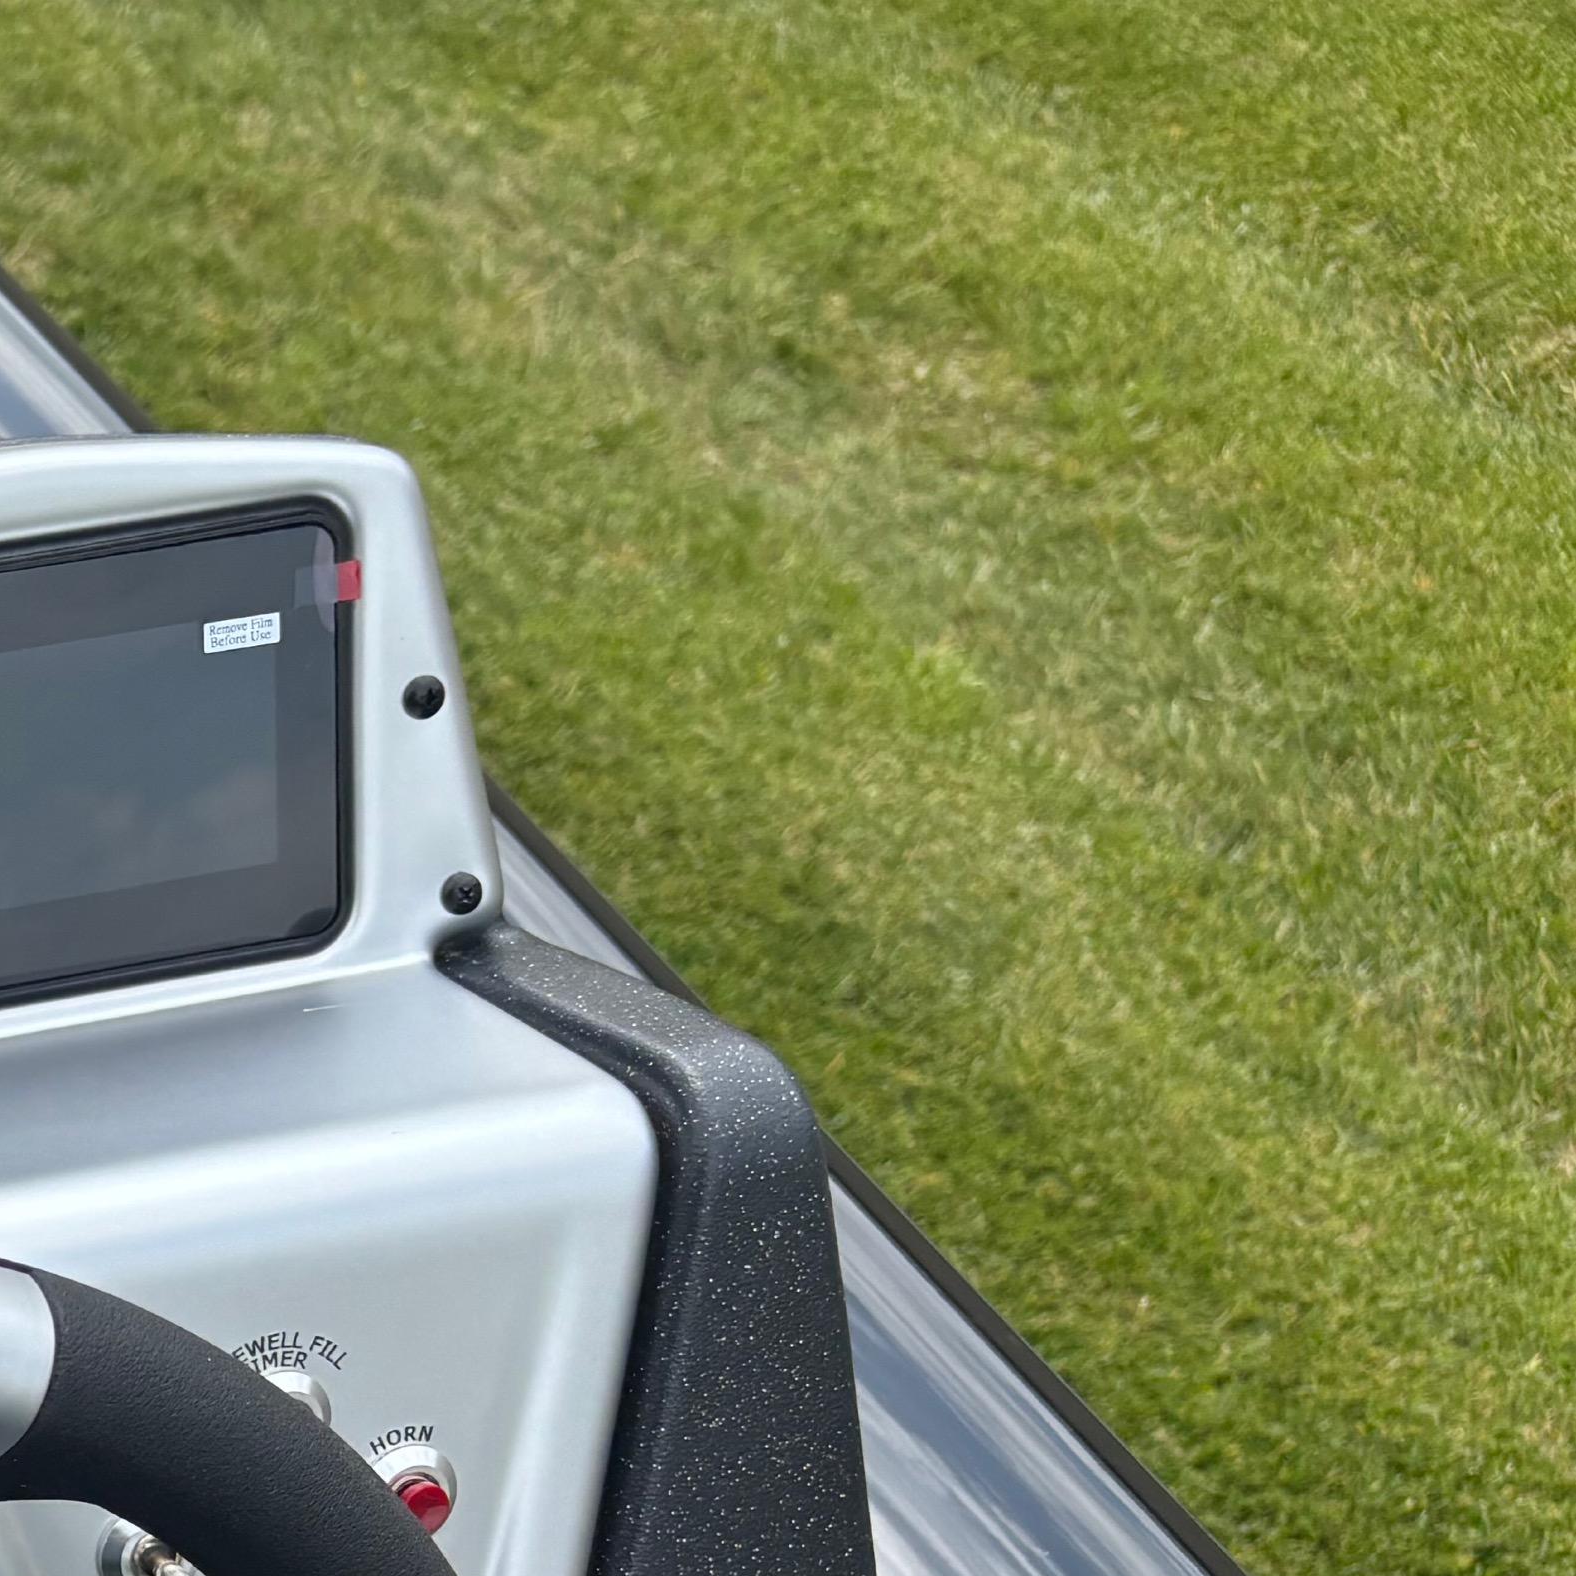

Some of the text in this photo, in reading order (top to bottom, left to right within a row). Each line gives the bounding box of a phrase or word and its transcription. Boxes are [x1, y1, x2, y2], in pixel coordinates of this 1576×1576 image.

[209, 618, 273, 636] Remove Film
[210, 630, 272, 648] Before Use
[244, 1350, 308, 1373] IMER
[309, 1335, 347, 1370] FILL
[369, 1425, 434, 1456] HORN
